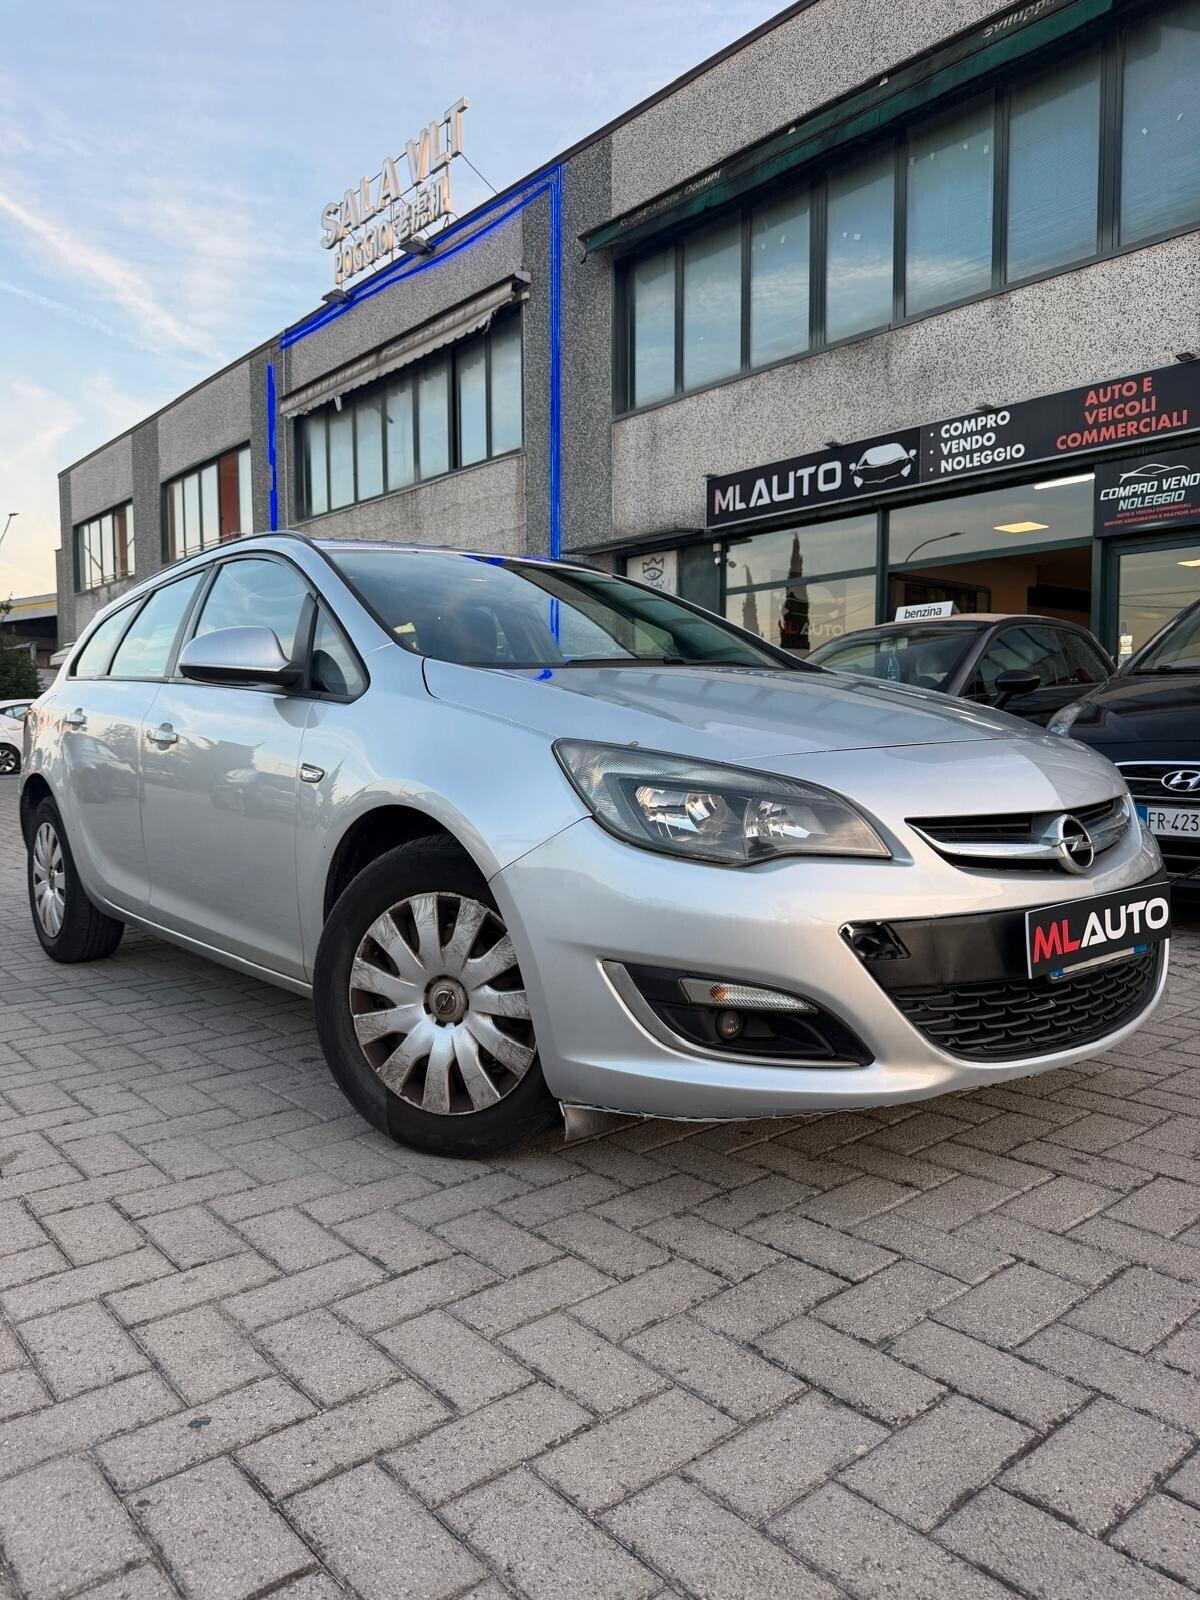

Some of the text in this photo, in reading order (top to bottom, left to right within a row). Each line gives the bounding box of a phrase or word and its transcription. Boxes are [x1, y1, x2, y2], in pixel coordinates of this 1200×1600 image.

[321, 97, 469, 249] SALA VLT
[335, 220, 393, 284] POGGIO
[1084, 377, 1153, 407] AUTO E
[940, 411, 1011, 439] COMPRO
[1084, 396, 1157, 425] VEICOLI
[940, 432, 996, 456] VENDO
[1056, 410, 1188, 450] COMMERCIALI
[940, 444, 1026, 474] NOLEGGIO
[1100, 473, 1200, 500] COMPRO VEND
[1118, 490, 1185, 511] NOLEGGIO
[903, 605, 942, 620] benzina
